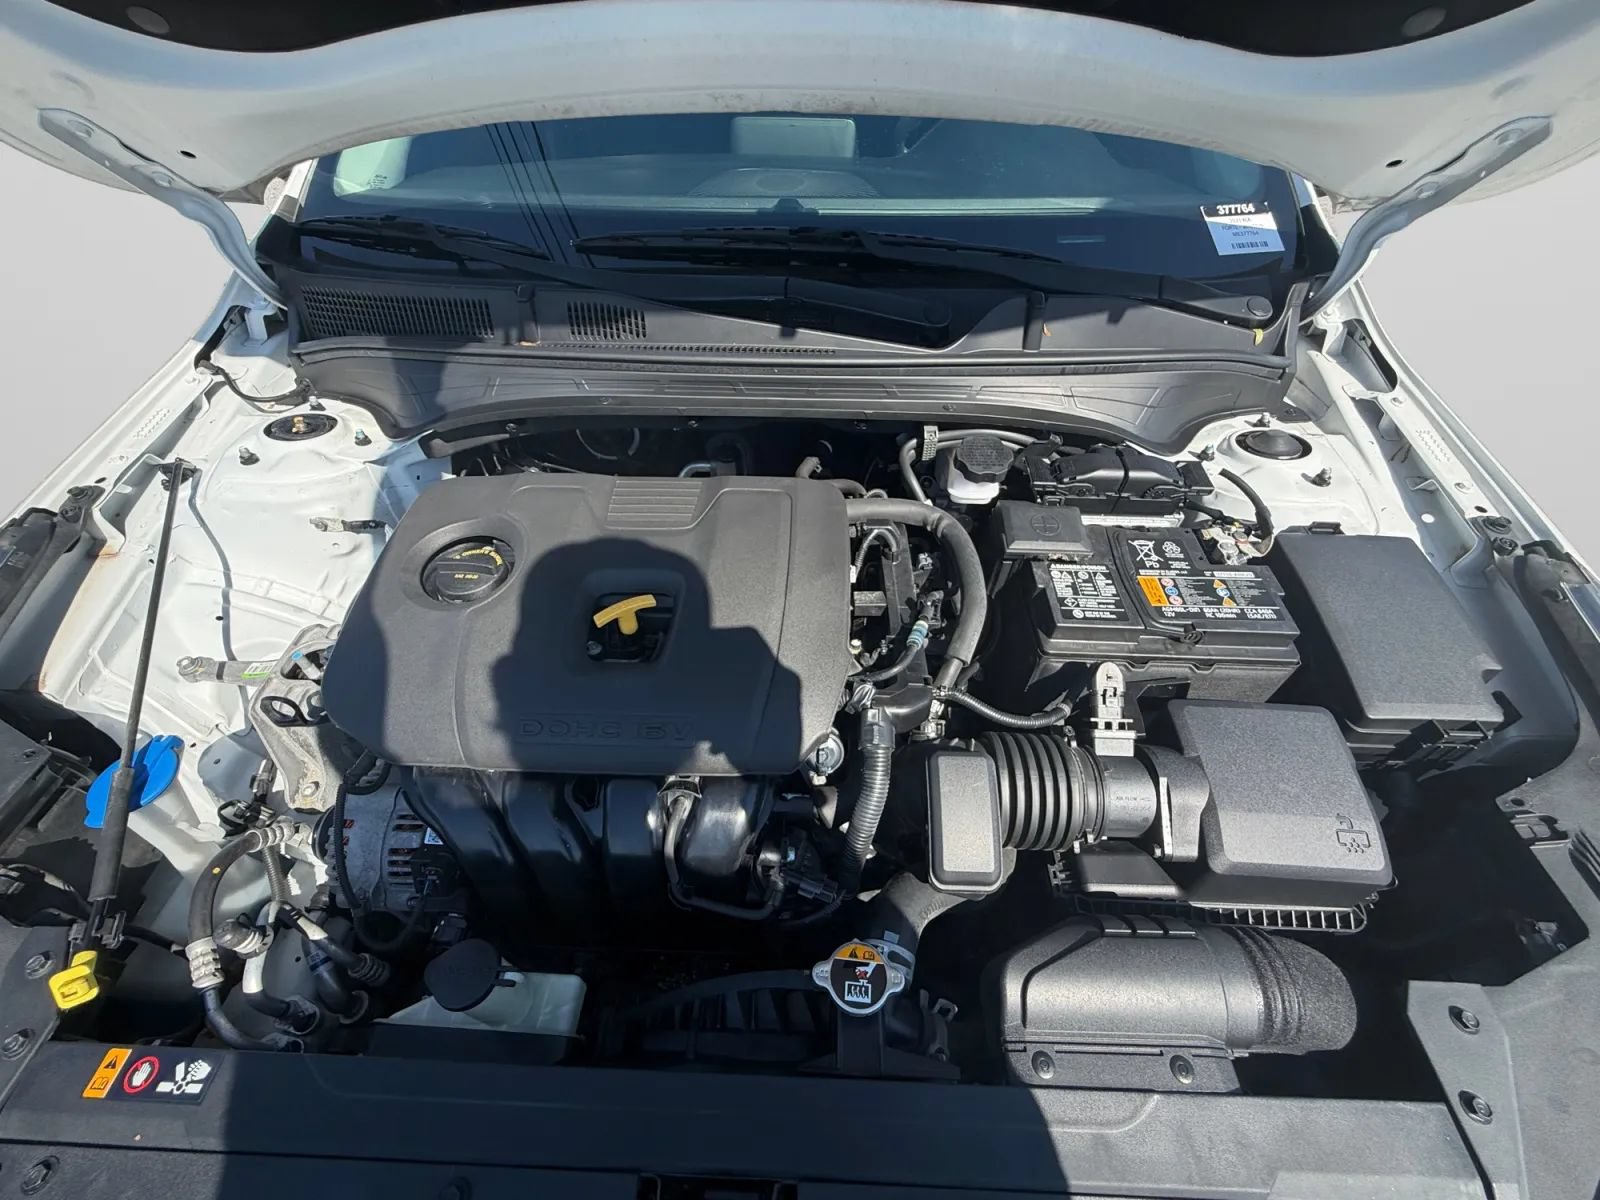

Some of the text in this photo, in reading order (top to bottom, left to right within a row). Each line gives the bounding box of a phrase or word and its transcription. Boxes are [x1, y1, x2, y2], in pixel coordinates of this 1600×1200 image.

[1216, 203, 1255, 214] 377764
[1145, 560, 1160, 569] Pb
[519, 719, 622, 738] DOHC
